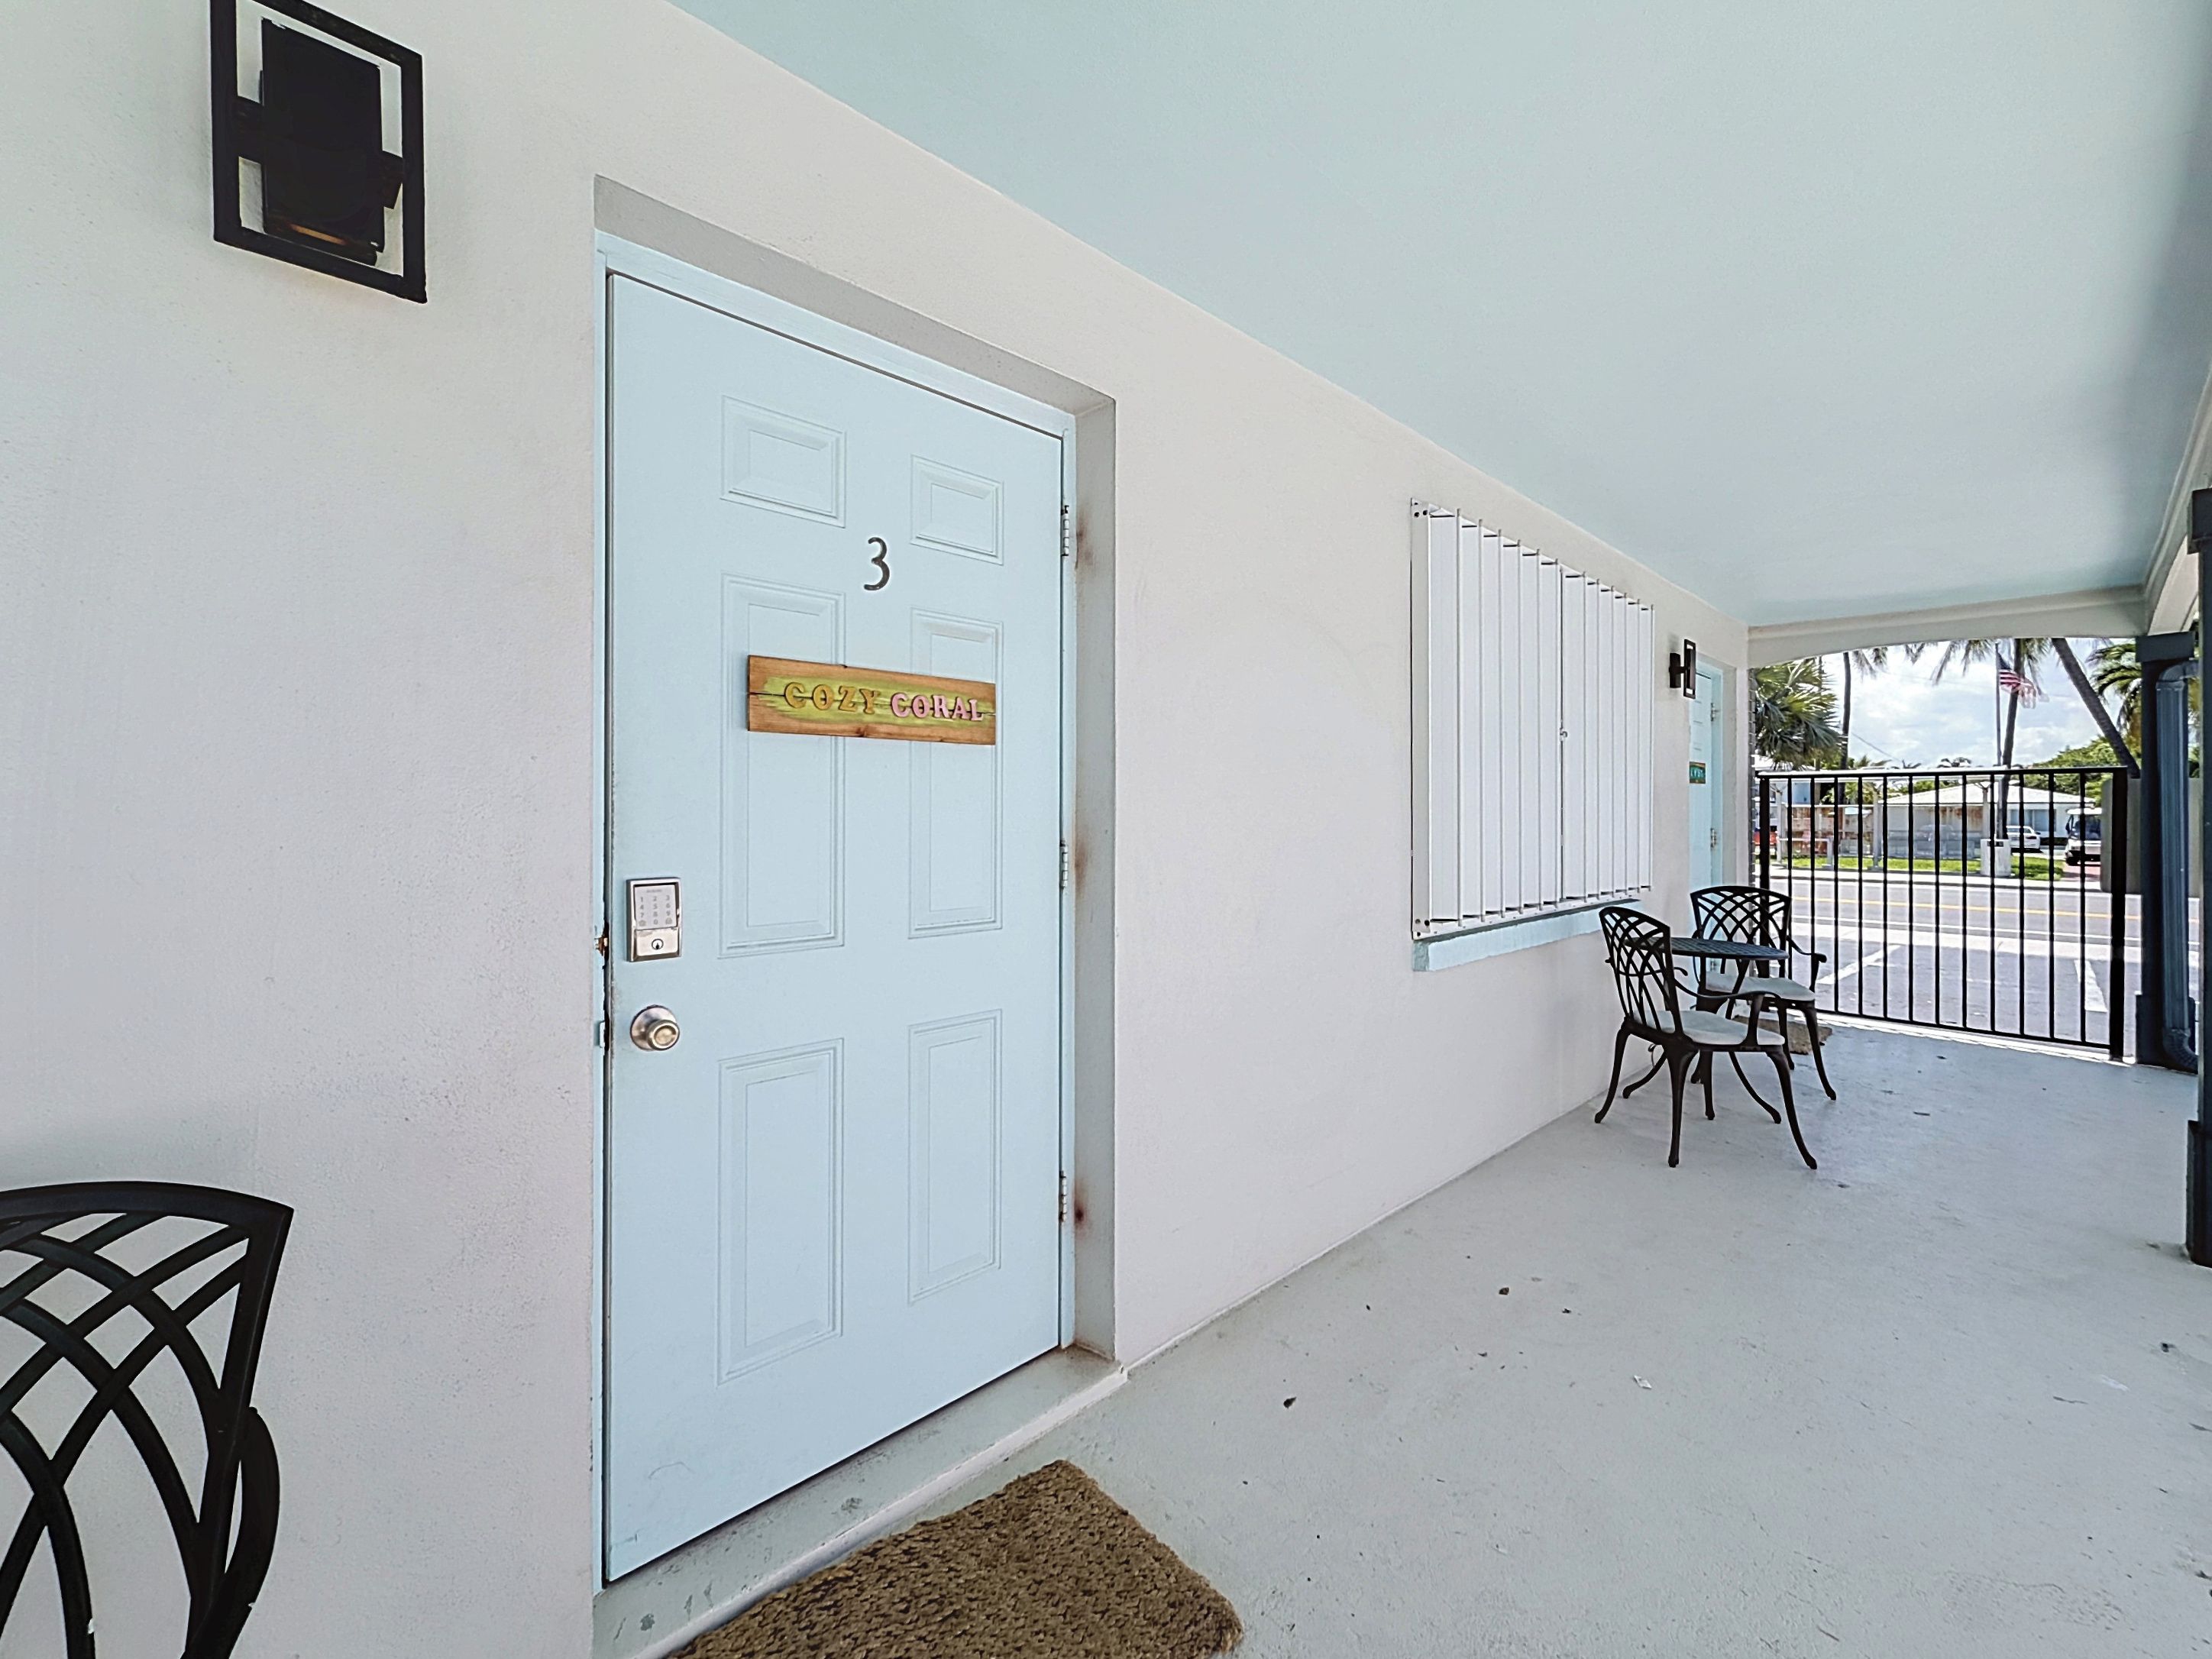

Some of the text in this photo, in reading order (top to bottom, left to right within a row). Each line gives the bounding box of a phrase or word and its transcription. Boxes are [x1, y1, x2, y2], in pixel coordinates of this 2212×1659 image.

[863, 536, 891, 590] 3
[784, 681, 984, 721] COZY CORAL
